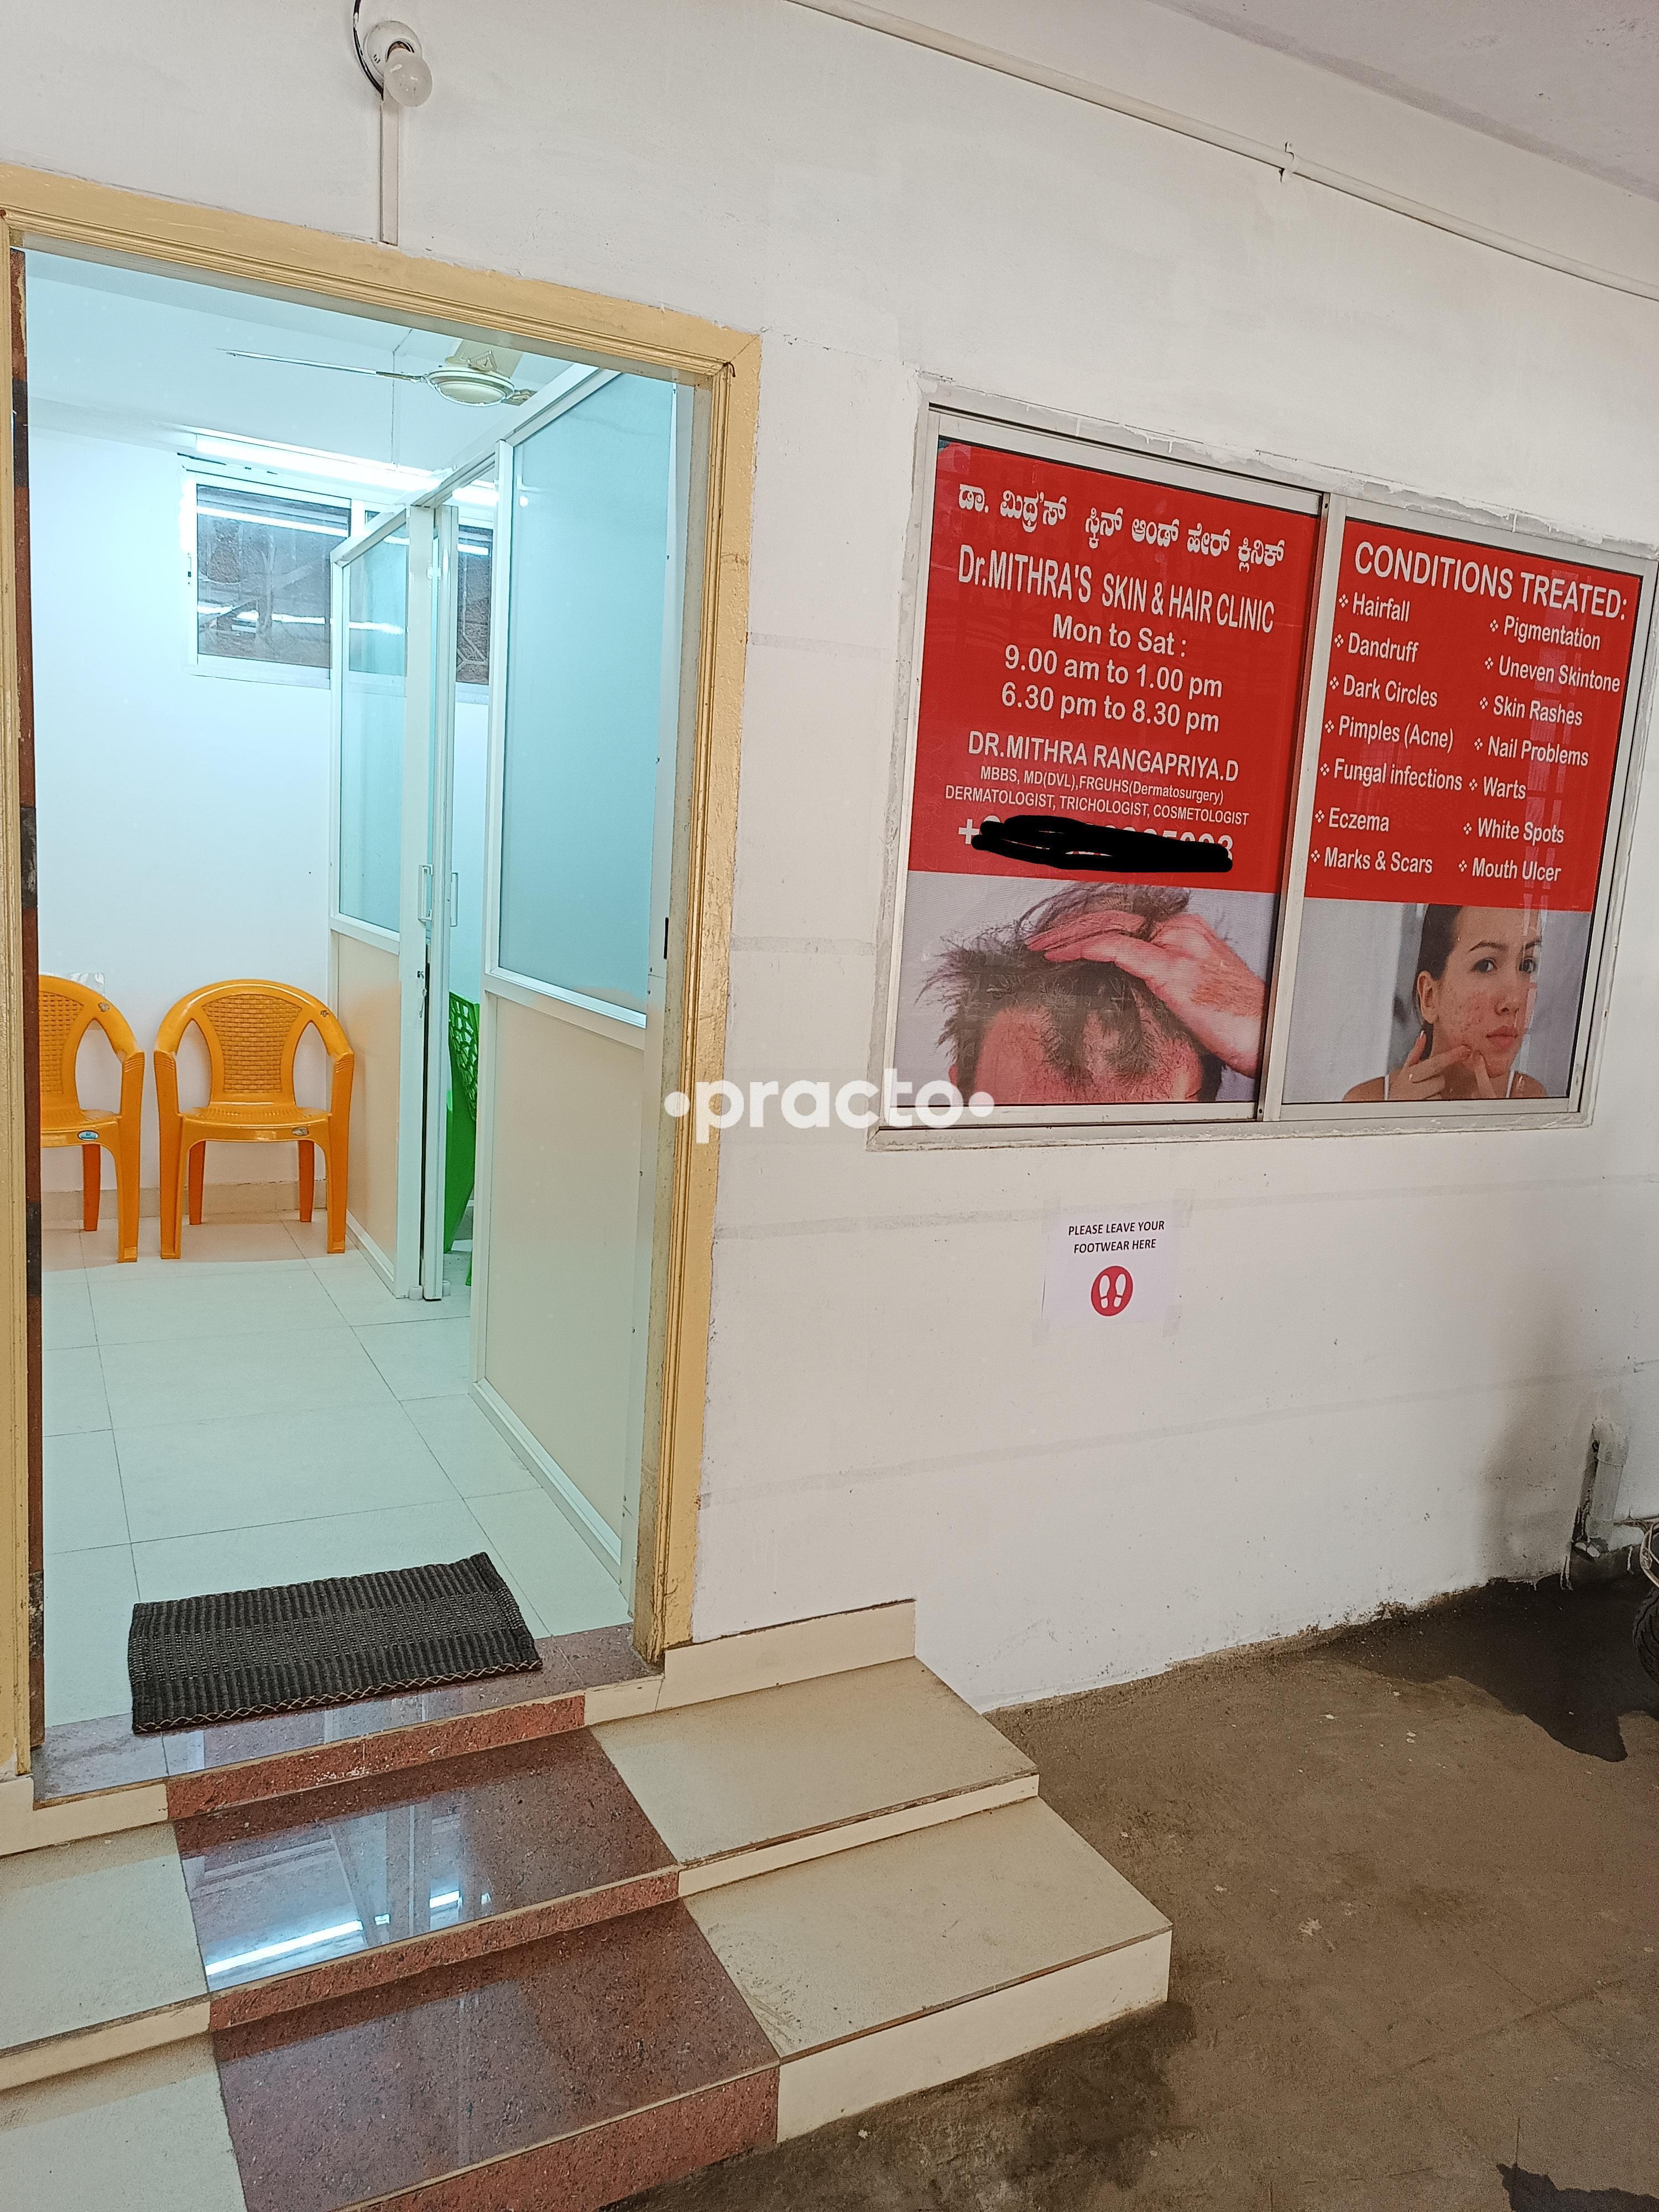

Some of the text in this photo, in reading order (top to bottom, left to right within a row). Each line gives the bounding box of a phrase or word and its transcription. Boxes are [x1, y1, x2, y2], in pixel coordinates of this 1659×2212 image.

[958, 483, 989, 513] ಡಾ.
[1355, 541, 1627, 620] CONDITIONS TREATED:
[1102, 573, 1147, 612] SKIN
[1151, 582, 1164, 615] &
[1168, 585, 1213, 623] HAIR
[1217, 593, 1275, 633] CLINIC
[1353, 592, 1410, 622] Hairfall
[1052, 613, 1102, 644] Mon
[1109, 623, 1131, 648] to
[1138, 627, 1175, 655] Sat
[1348, 632, 1419, 662] Dandruff
[1504, 615, 1600, 650] Pigmentation
[1005, 644, 1222, 700] 9.00 am to 1.00 pm
[1499, 655, 1620, 692] Uneven Skintone
[1343, 674, 1437, 707] Dark Circles
[1001, 681, 1219, 734] 6.30 pm to 8.30 pm
[1493, 695, 1583, 726] Skin Rashes
[1339, 715, 1453, 753] Pimples (Acne)
[1488, 735, 1589, 766] Nail Problems
[980, 765, 1020, 785] MBBS,
[1334, 758, 1462, 791] Fungal infections
[1484, 776, 1526, 800] Warts
[945, 785, 1249, 825] DERMATOLOGIST, TRICHOLOGIST, COSMETOLOGIST
[1329, 807, 1389, 832] Eczema
[1478, 817, 1564, 846] White Spots
[1324, 847, 1433, 873] Marks & Scars
[1472, 857, 1562, 881] Mouth Ulcer
[1068, 1220, 1165, 1236] PLEASE LEAVE YOUR
[1074, 1239, 1156, 1254] FOOTWEAR HERE
